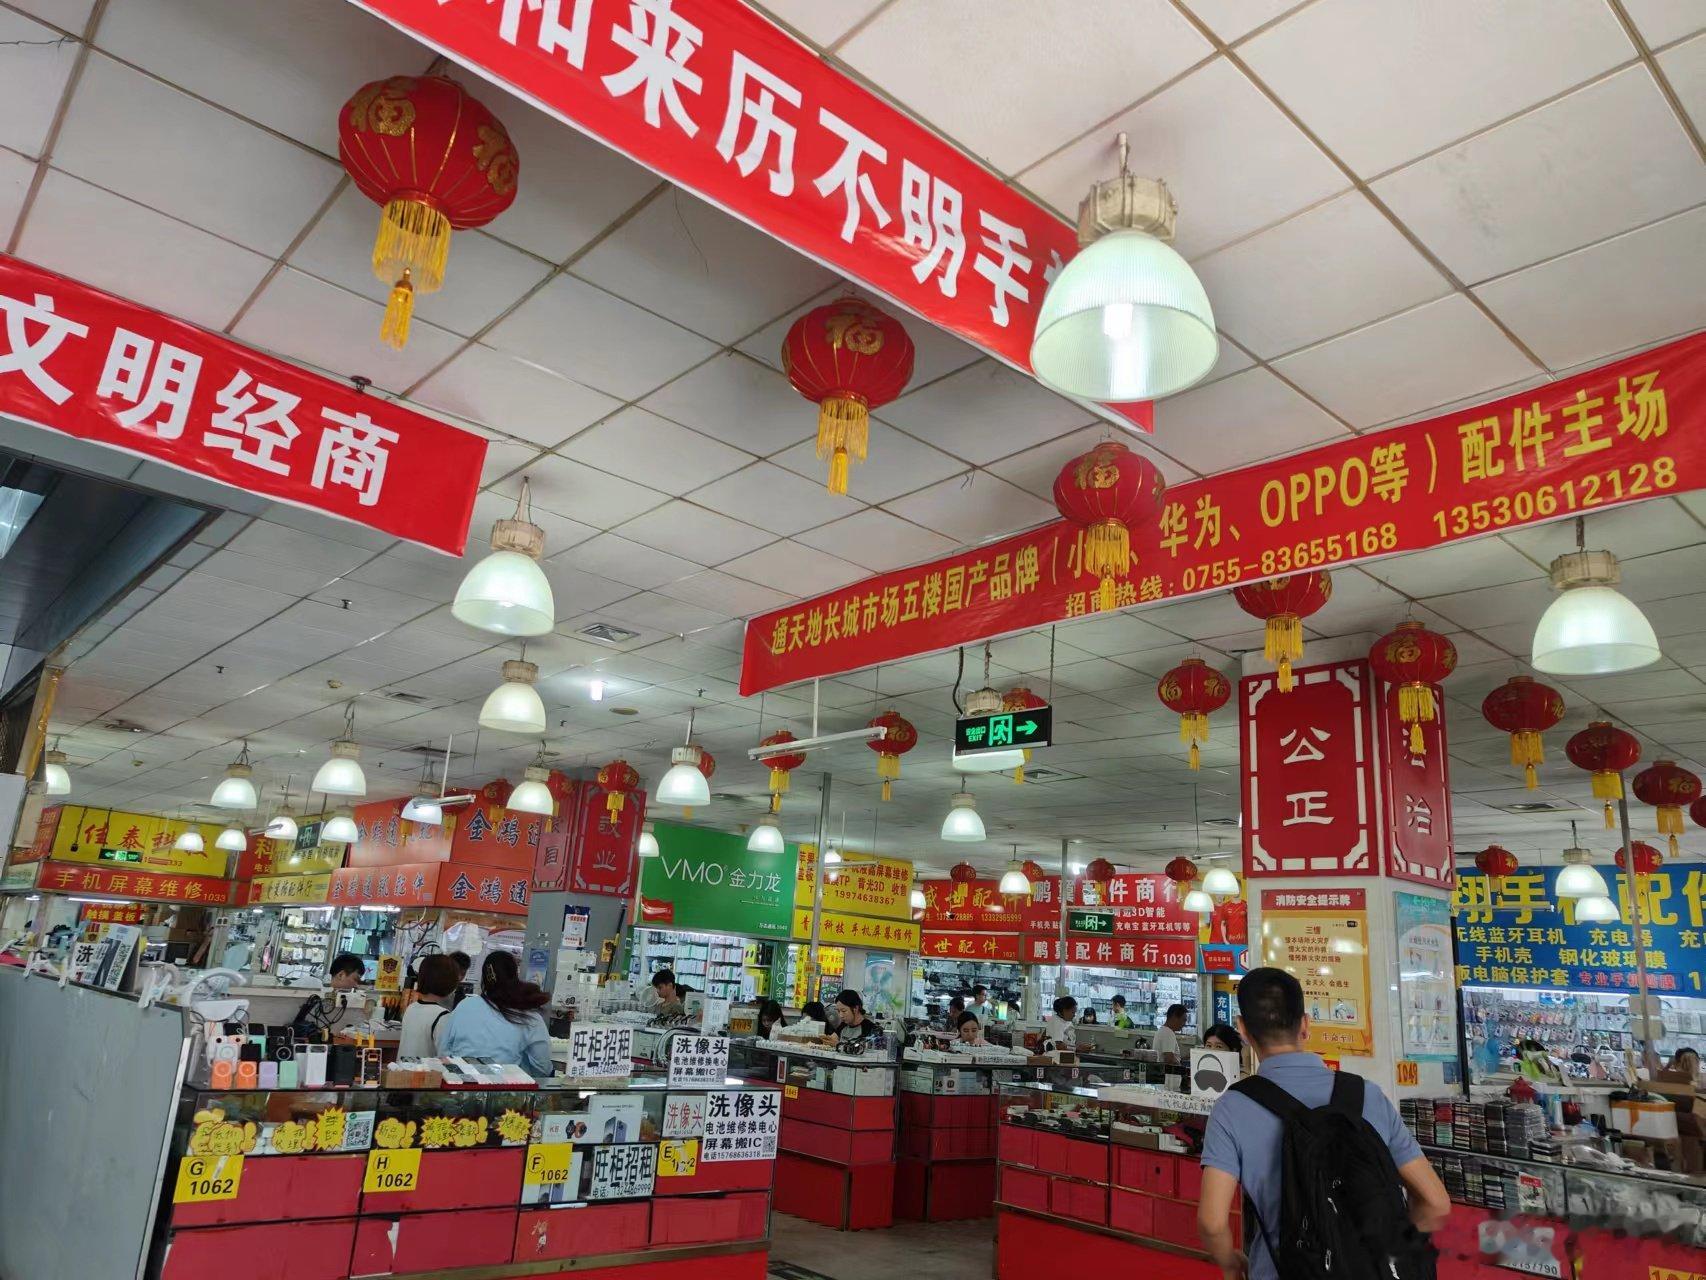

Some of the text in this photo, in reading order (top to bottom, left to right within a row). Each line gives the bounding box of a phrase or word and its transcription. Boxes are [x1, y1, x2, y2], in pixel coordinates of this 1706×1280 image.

[0, 294, 400, 507] 文明经商
[1181, 522, 1398, 592] 0755-83655168
[1432, 457, 1678, 539] 13530612128
[1280, 727, 1335, 827] 公正
[661, 856, 781, 893] VMO 金力龙
[55, 870, 226, 902] 手机屏幕维修 1033
[835, 889, 895, 906] 19974638367
[1275, 894, 1351, 906] 消防安全提示牌
[1115, 921, 1140, 931] 充电宝
[1162, 953, 1192, 966] 1030
[1475, 946, 1533, 963] 手机壳
[573, 1028, 631, 1067] 旺柜招租
[676, 1037, 728, 1055] 洗像头
[1397, 1062, 1418, 1084] 1049
[708, 1093, 778, 1118] 洗像头
[665, 1102, 703, 1130] 洗像头
[705, 1121, 777, 1135] 电池维修换电心
[663, 1146, 673, 1159] E
[704, 1137, 762, 1151] 屏幕搬IC
[376, 1156, 388, 1169] H
[531, 1156, 541, 1170] F
[703, 1151, 760, 1160] 电话15768636318
[189, 1161, 204, 1176] G
[541, 1169, 569, 1181] 1062
[593, 1146, 653, 1188] 旺柜招租
[190, 1179, 234, 1196] 1062
[376, 1173, 413, 1188] 1062
